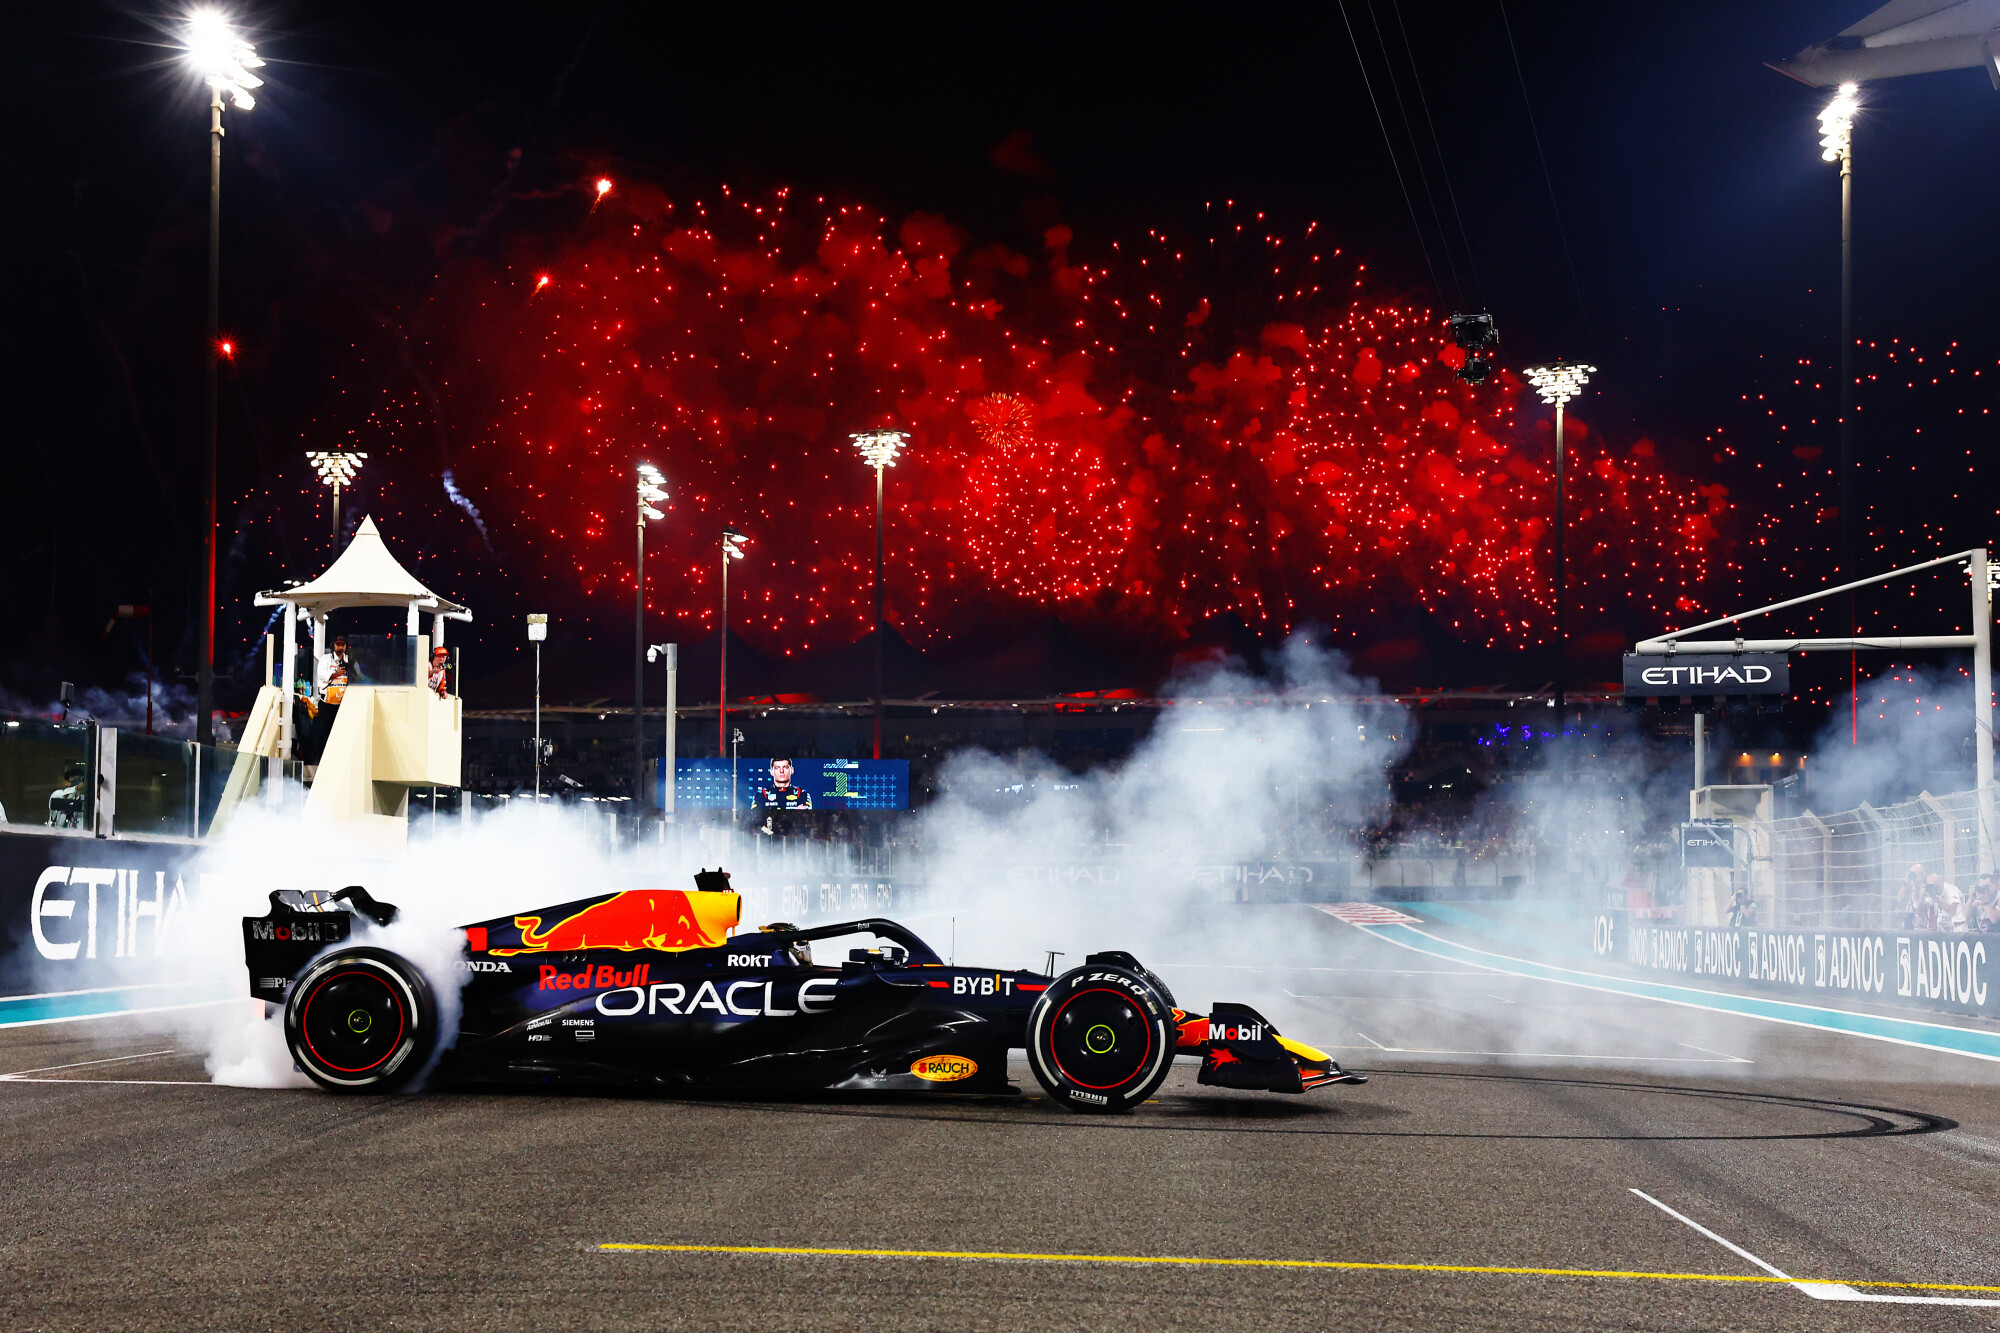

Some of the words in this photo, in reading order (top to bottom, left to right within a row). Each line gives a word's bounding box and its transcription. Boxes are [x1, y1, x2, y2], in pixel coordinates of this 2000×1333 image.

[1641, 665, 1772, 685] ETIHAD
[1007, 866, 1120, 884] ETIHAD
[1191, 865, 1313, 884] ETIHAD
[783, 884, 809, 916] ETIHAD
[820, 883, 842, 913] ETIHAD
[850, 883, 869, 910] ETIHAD
[877, 884, 892, 908] ETIHAD
[252, 920, 321, 941] Mobil
[727, 954, 772, 968] ROKT
[1659, 930, 1688, 972] ADNOC
[1704, 931, 1741, 978] ADNOC
[1761, 933, 1806, 985] ADNOC
[451, 961, 512, 973] ONDA
[1829, 936, 1884, 993] ADNOC
[1916, 939, 1987, 1006] ADNOC
[539, 964, 594, 991] Red
[595, 963, 650, 988] Bull
[953, 974, 1015, 996] BYBIT
[1071, 975, 1084, 988] P
[1088, 972, 1146, 996] ZERO
[596, 978, 840, 1017] ORACLE
[562, 1019, 595, 1027] SIEMENS
[1209, 1023, 1262, 1041] Mobil
[928, 1062, 969, 1074] RAUCH
[1069, 1089, 1108, 1106] PIRELLI
